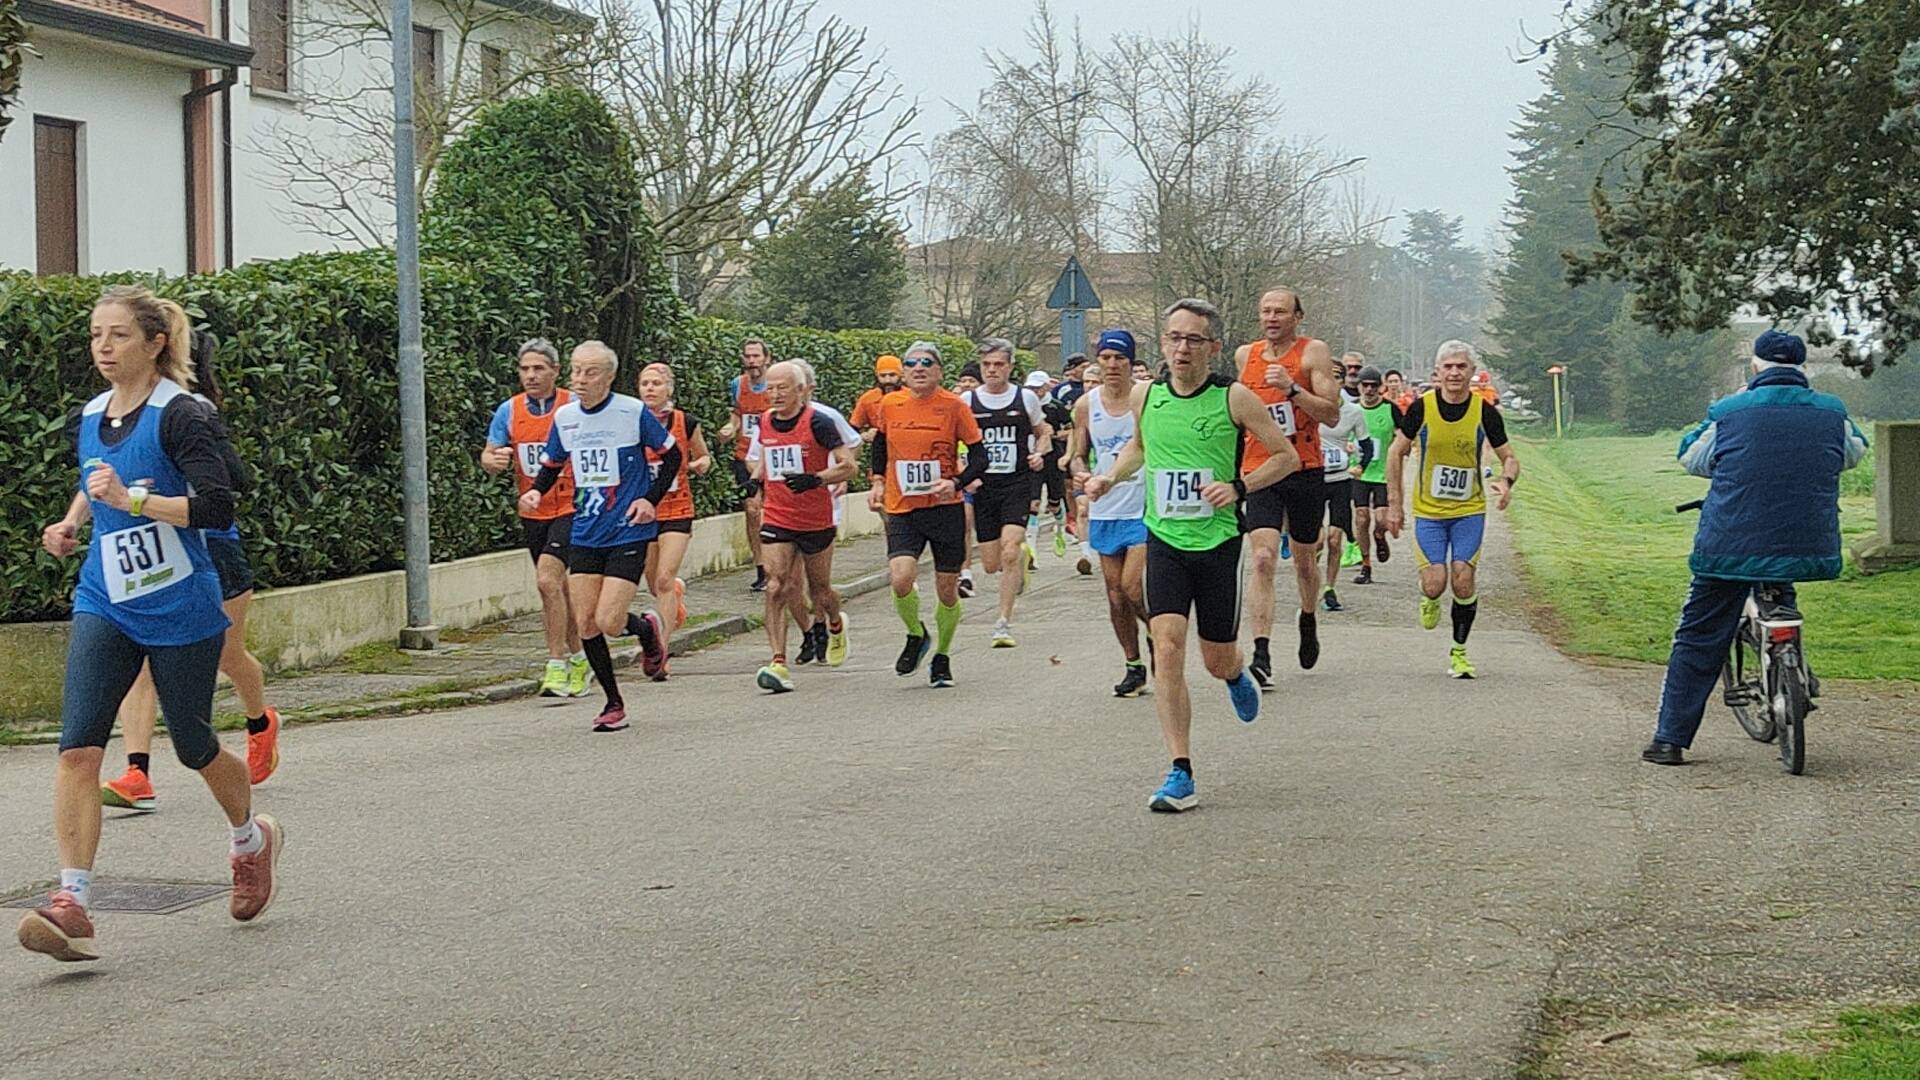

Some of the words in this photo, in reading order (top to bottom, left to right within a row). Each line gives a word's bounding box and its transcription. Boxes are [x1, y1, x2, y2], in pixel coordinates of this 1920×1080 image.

[1268, 405, 1286, 425] 15
[527, 445, 546, 465] 68
[580, 449, 609, 473] 542
[771, 447, 795, 468] 674
[907, 463, 931, 483] 618
[1440, 467, 1467, 489] 530
[1166, 472, 1201, 501] 754
[115, 525, 165, 575] 537
